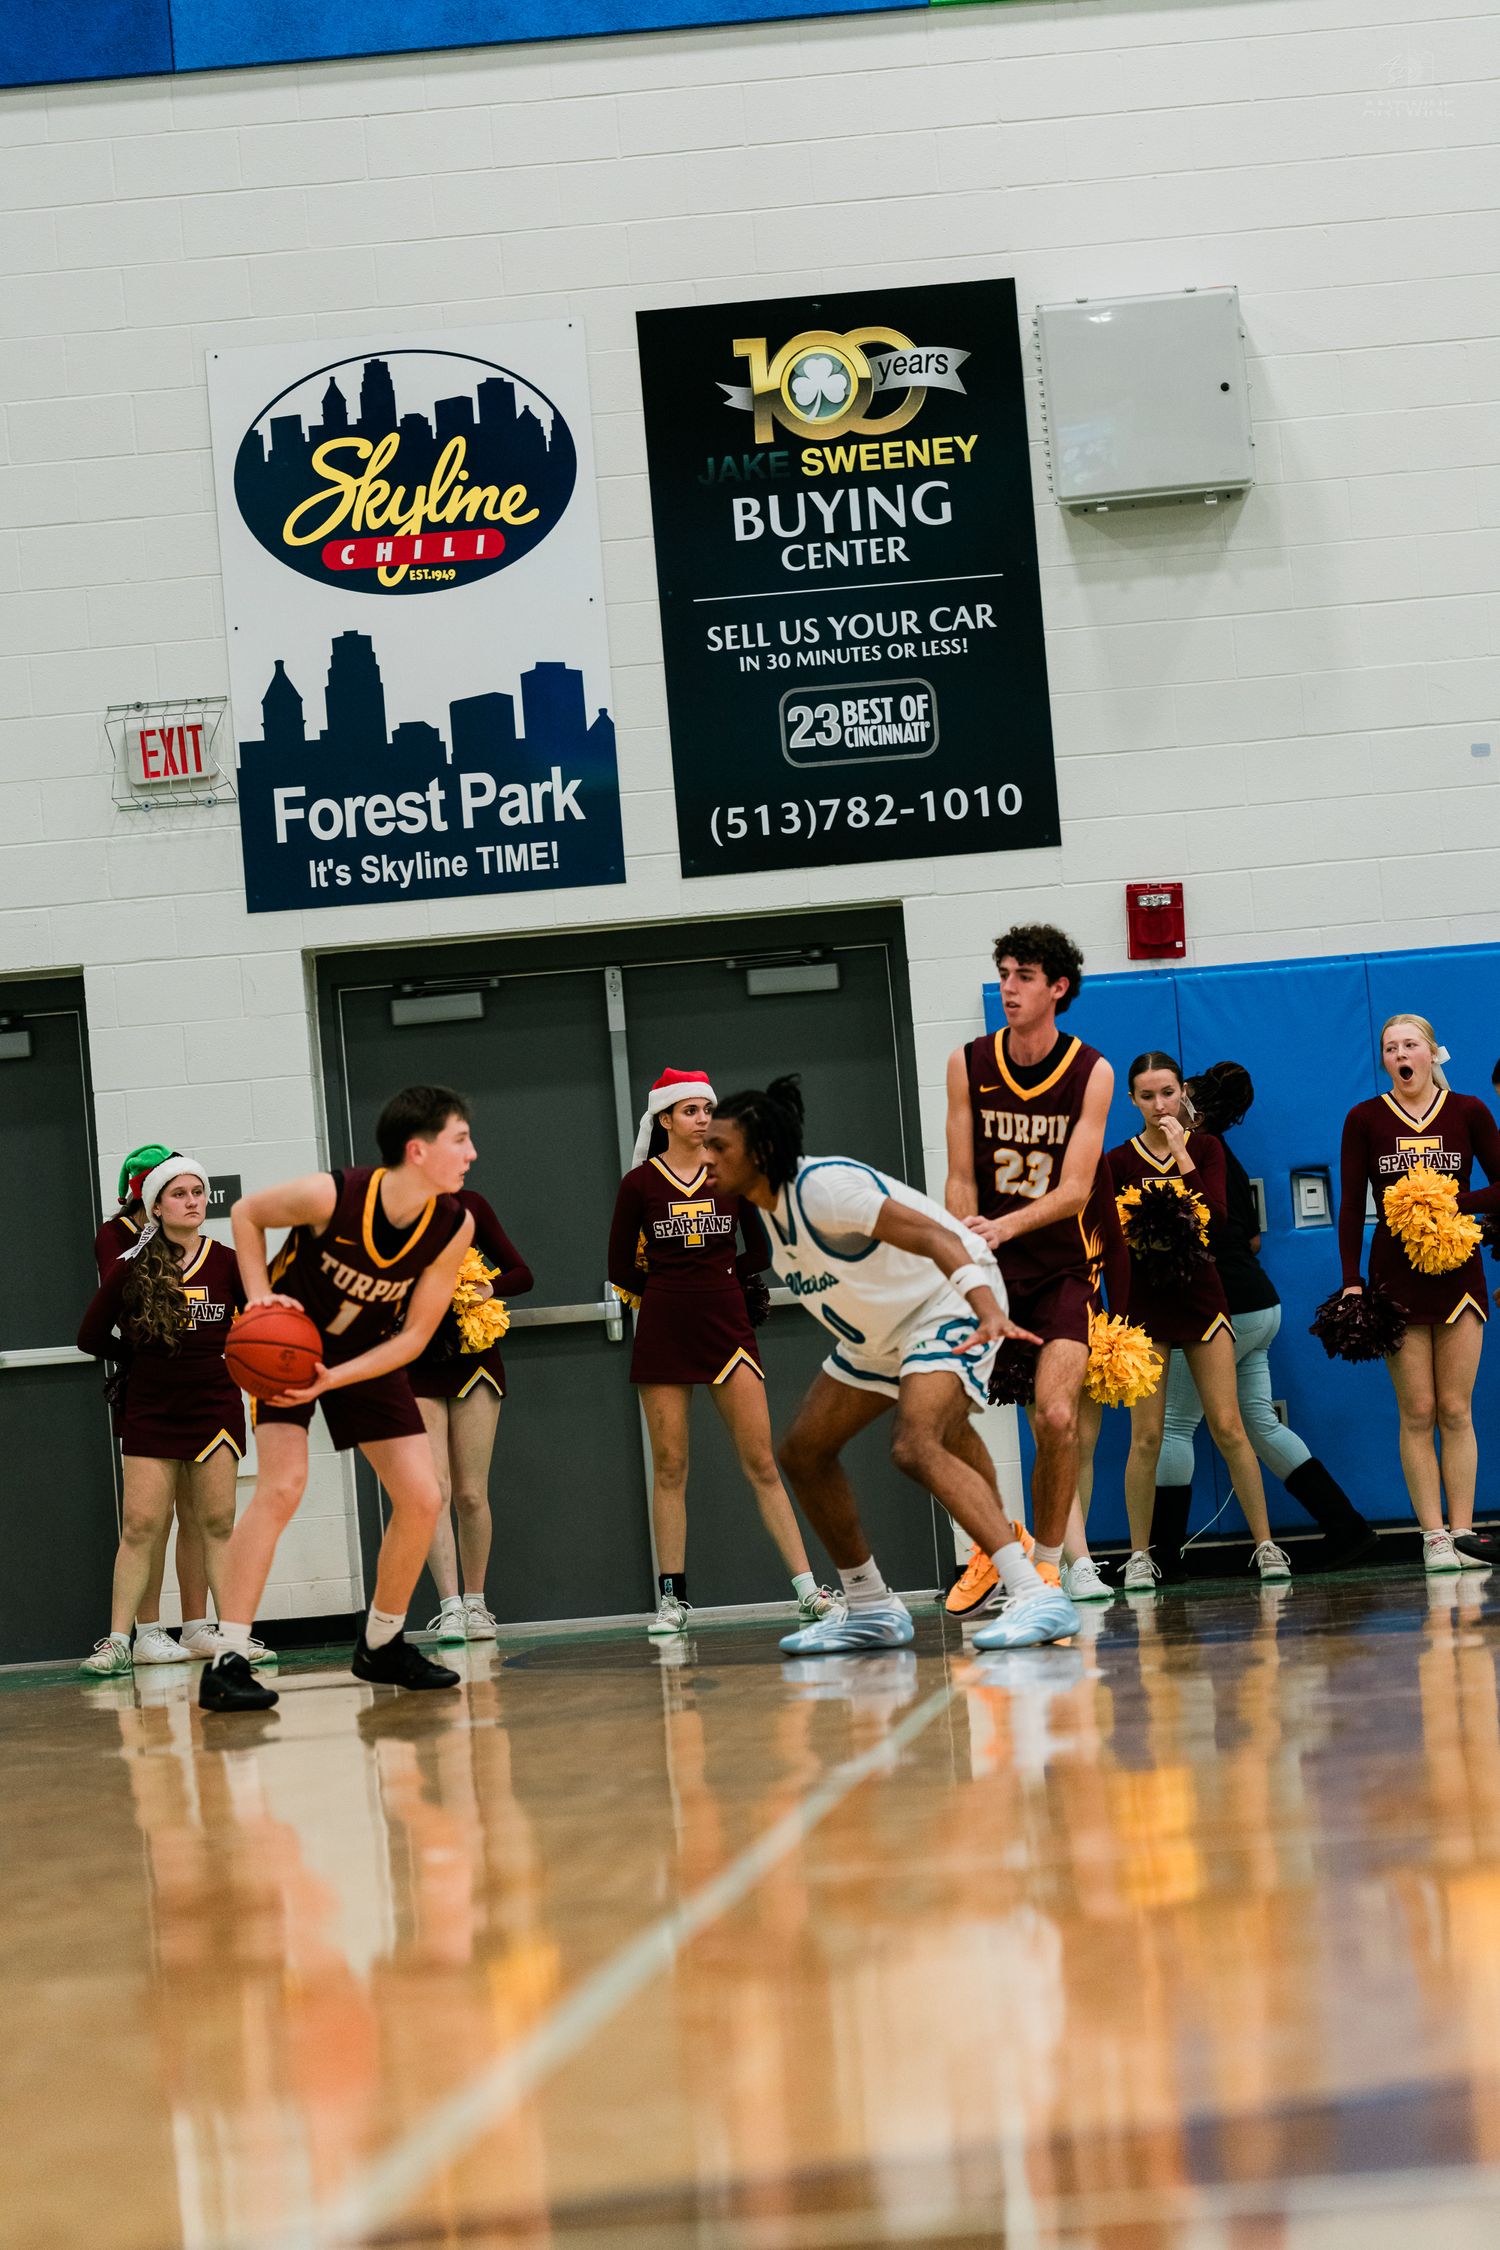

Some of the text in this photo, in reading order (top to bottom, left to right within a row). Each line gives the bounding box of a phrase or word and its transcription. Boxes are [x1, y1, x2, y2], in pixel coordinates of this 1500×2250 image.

[732, 327, 949, 444] 100 years
[697, 434, 979, 485] JAKE SWEENEY
[282, 432, 540, 587] Skyline
[732, 480, 952, 541] BUYING
[340, 534, 485, 566] CHILI
[409, 568, 456, 581] EST.1949
[781, 536, 911, 571] CENTER
[706, 603, 998, 652] SELL US YOUR CAR
[739, 637, 969, 672] IN 30 MINUTES OR LESS!
[787, 703, 842, 749] 23
[841, 693, 929, 727] BEST OF
[139, 723, 203, 779] EXIT
[273, 766, 586, 844] Forest Park
[710, 783, 1023, 847] (513)782-1010
[308, 840, 560, 890] It's Skyline TIME!
[979, 1108, 1070, 1146] TURPIN
[993, 1147, 1054, 1199] 23
[652, 1215, 733, 1239] SPARTANS
[324, 1299, 364, 1336] 1
